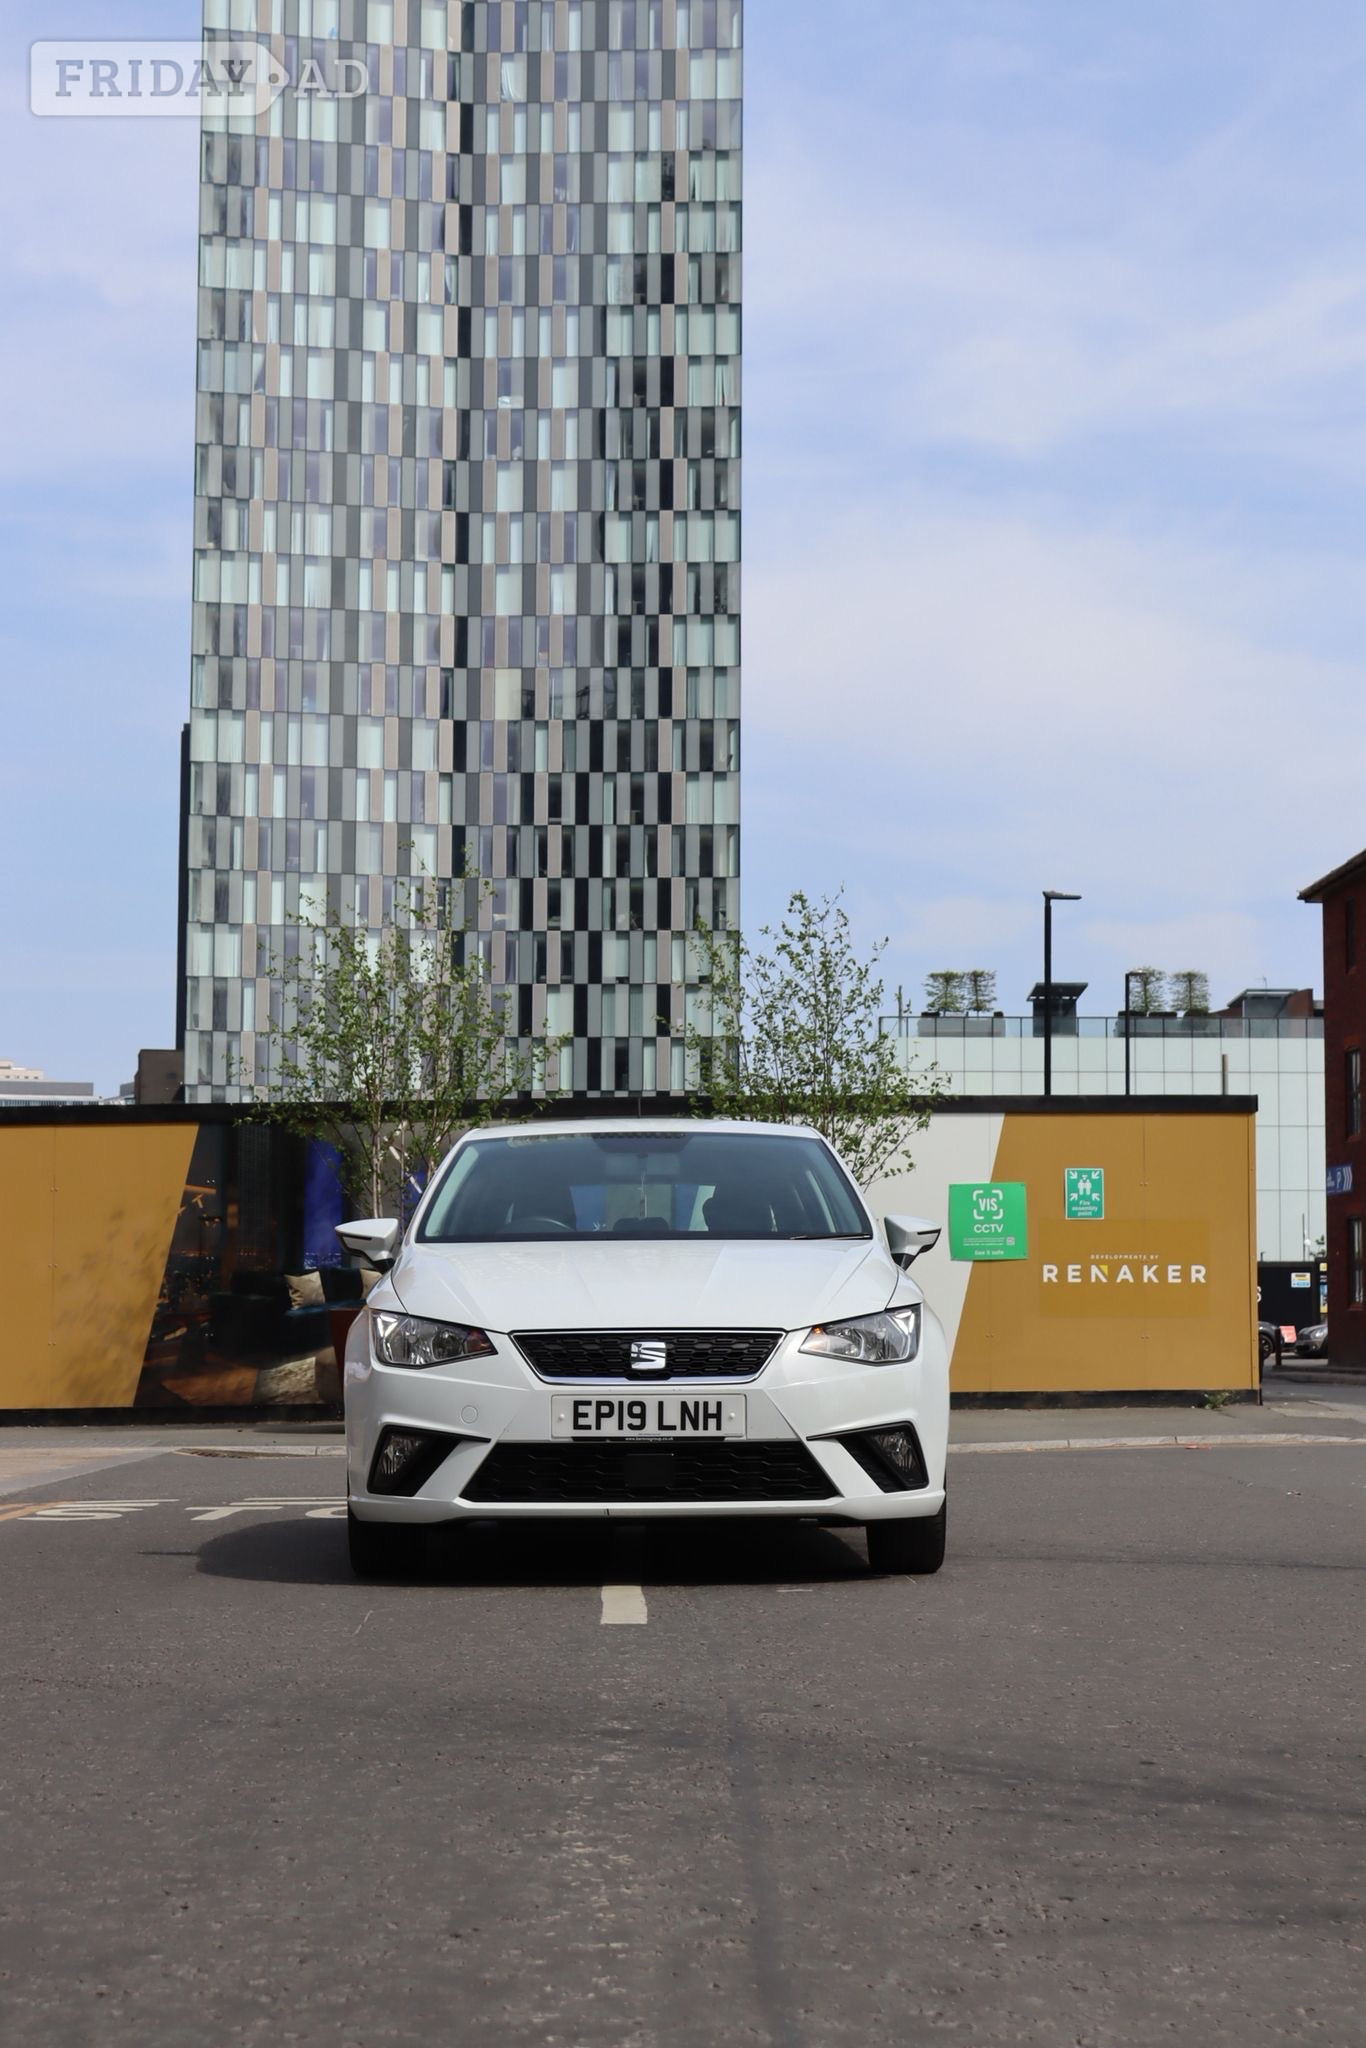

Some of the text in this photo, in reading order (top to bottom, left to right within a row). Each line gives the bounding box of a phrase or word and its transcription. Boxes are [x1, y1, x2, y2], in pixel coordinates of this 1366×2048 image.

[978, 1198, 998, 1212] VIS
[973, 1224, 1004, 1233] CCTV
[1042, 1264, 1207, 1283] RENAKER
[573, 1400, 722, 1431] EP19 LNH
